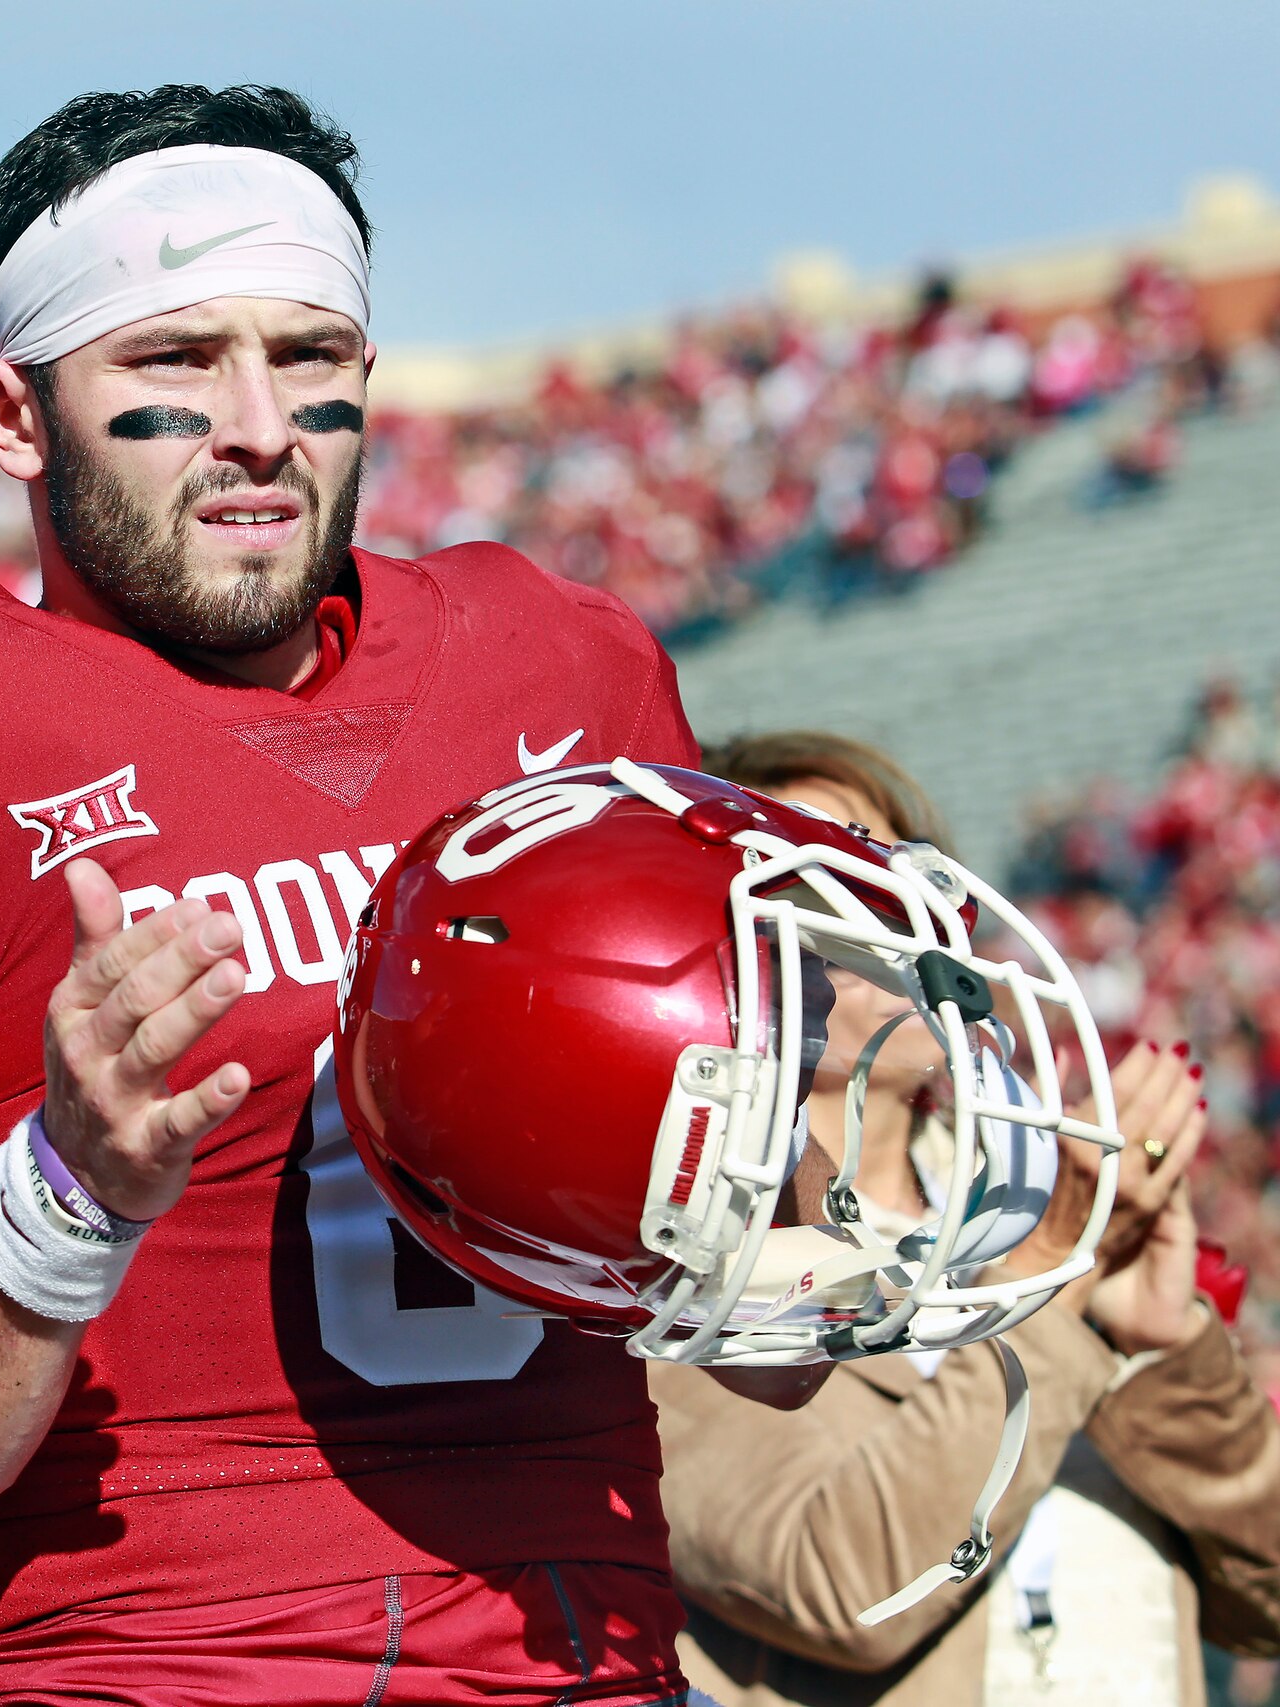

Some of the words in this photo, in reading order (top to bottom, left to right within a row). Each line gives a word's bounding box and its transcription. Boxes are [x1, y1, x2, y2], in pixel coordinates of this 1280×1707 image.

[20, 774, 147, 867] XII
[29, 1162, 51, 1213] HYPE
[669, 1106, 712, 1206] OKLAHOMA
